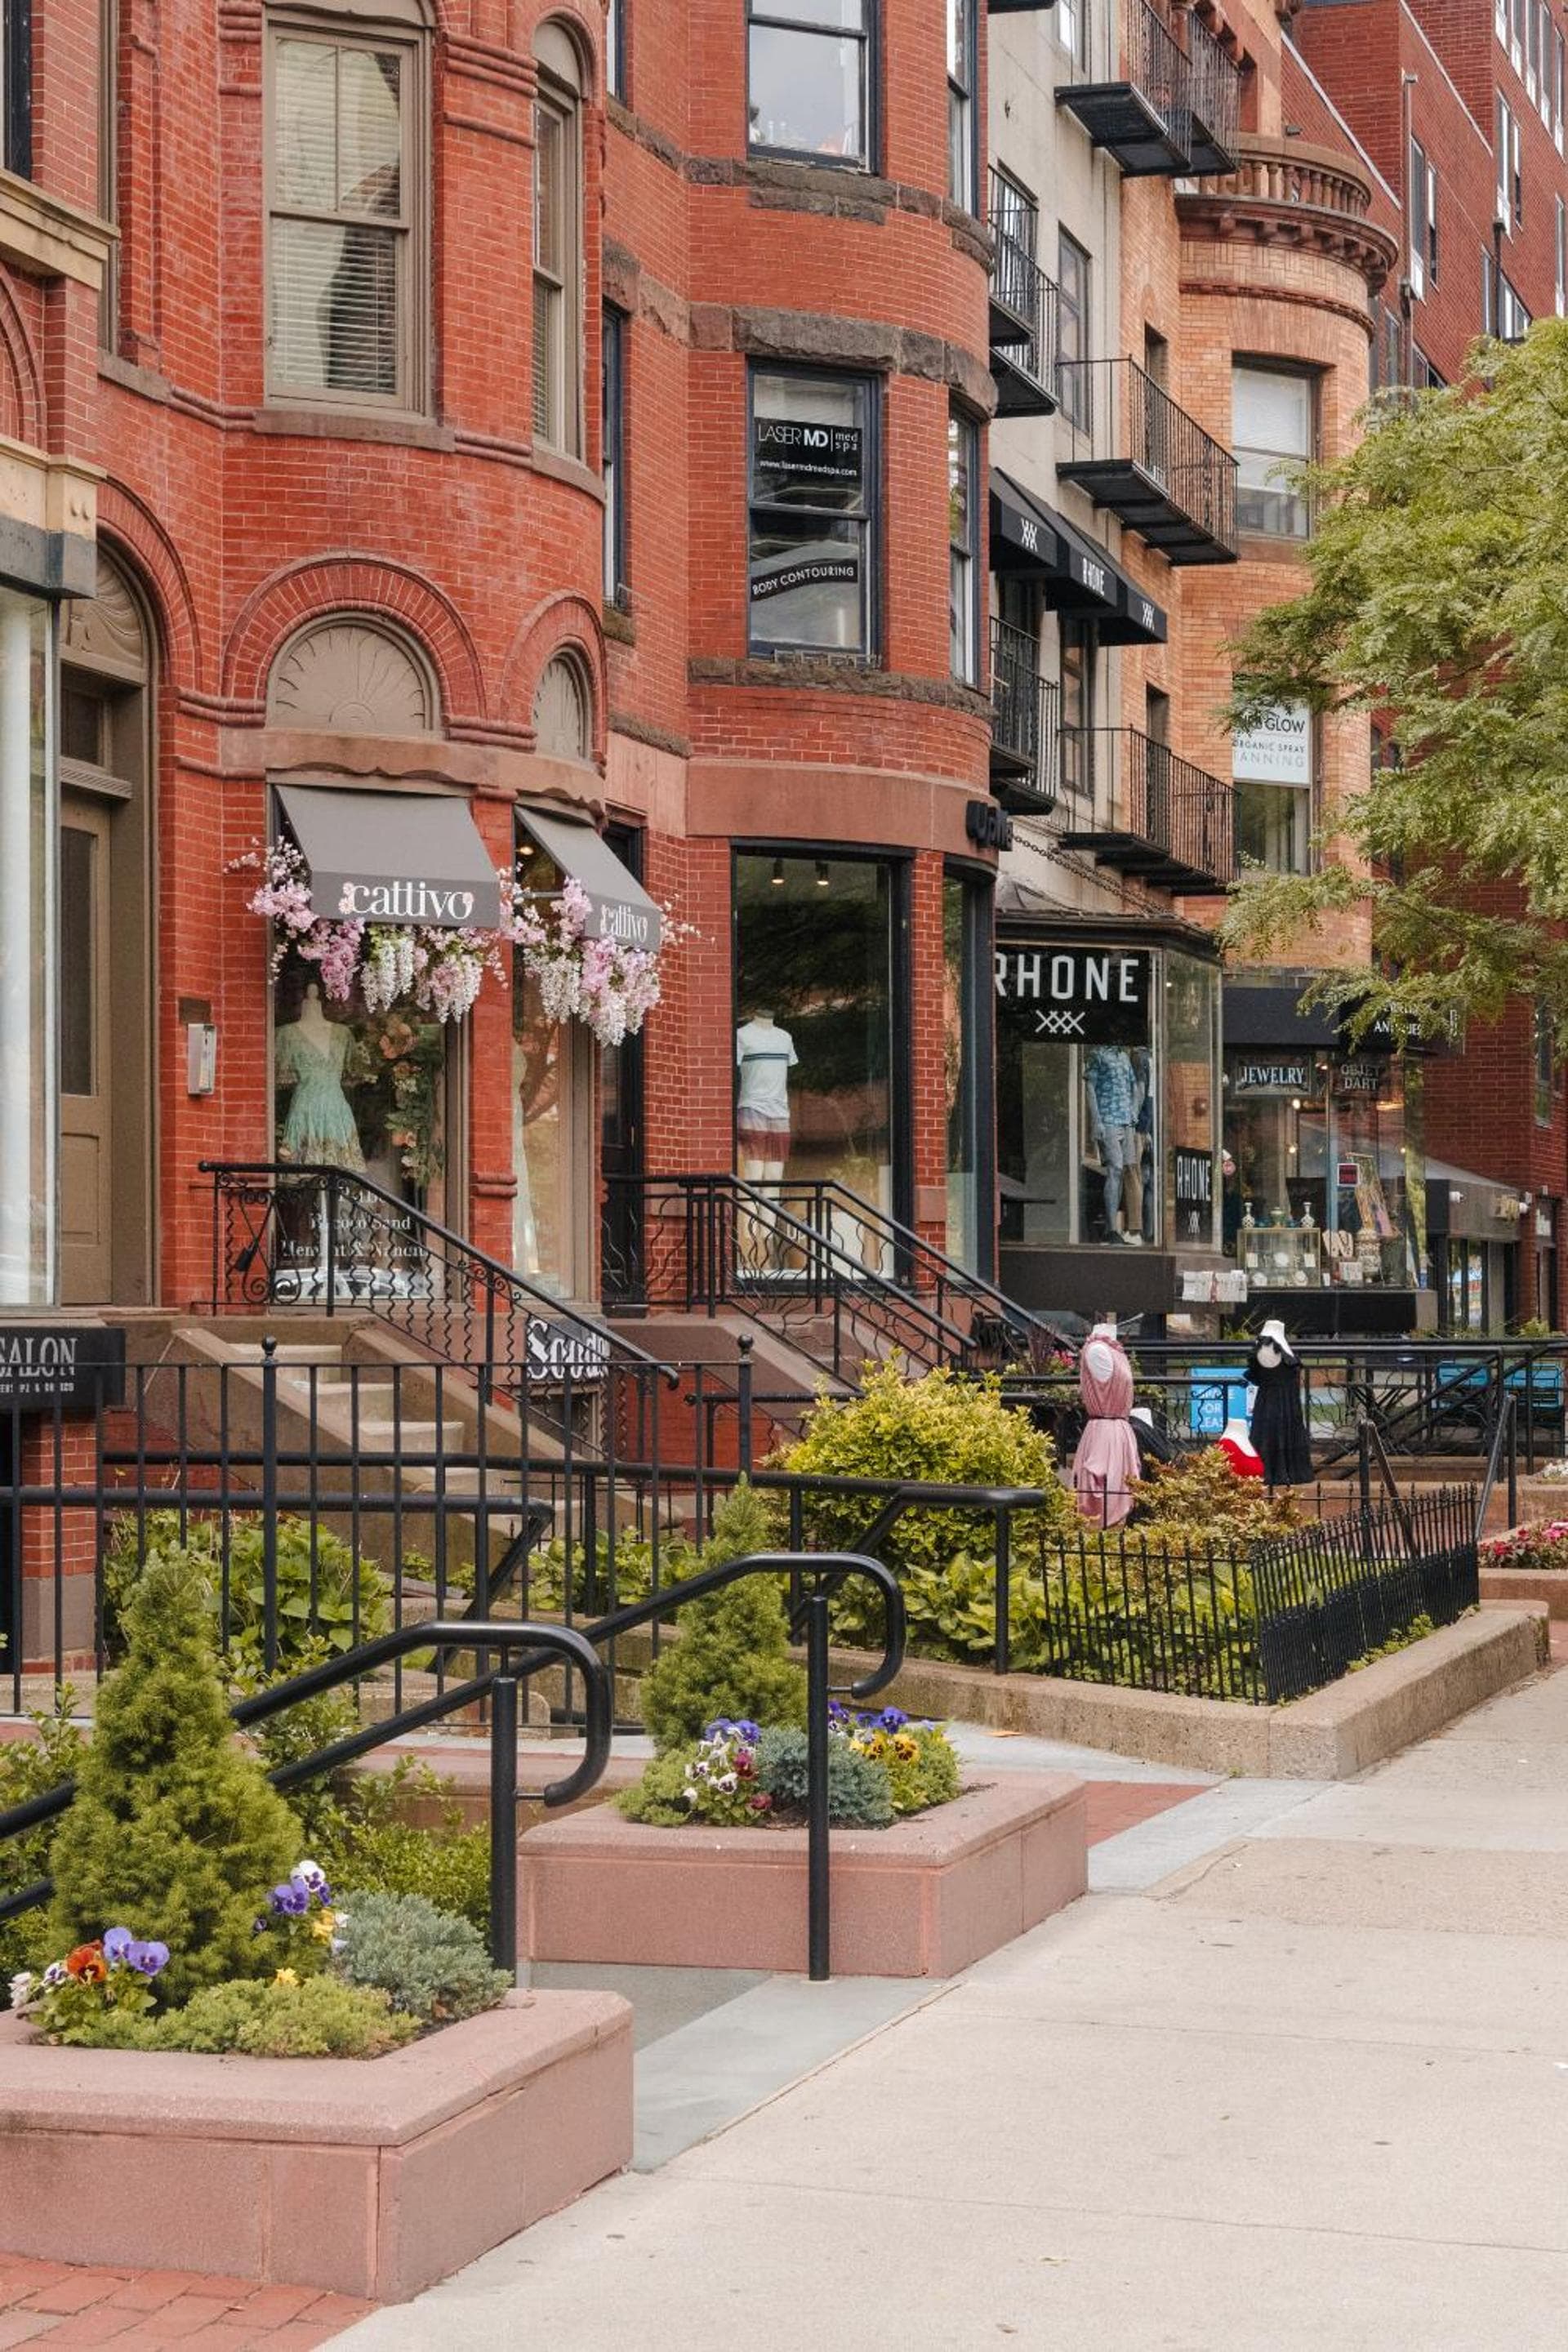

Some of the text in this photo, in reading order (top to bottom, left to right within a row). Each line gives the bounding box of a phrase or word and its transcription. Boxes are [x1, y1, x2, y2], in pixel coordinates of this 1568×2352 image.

[758, 424, 829, 448] LASER MD
[835, 431, 858, 442] med
[835, 442, 858, 452] spa
[751, 566, 854, 595] BODY CONTOURING
[348, 880, 474, 920] cattivo
[601, 904, 648, 942] cattivo
[1240, 1066, 1306, 1085] JEWELRY
[1177, 1155, 1212, 1202] RHONE
